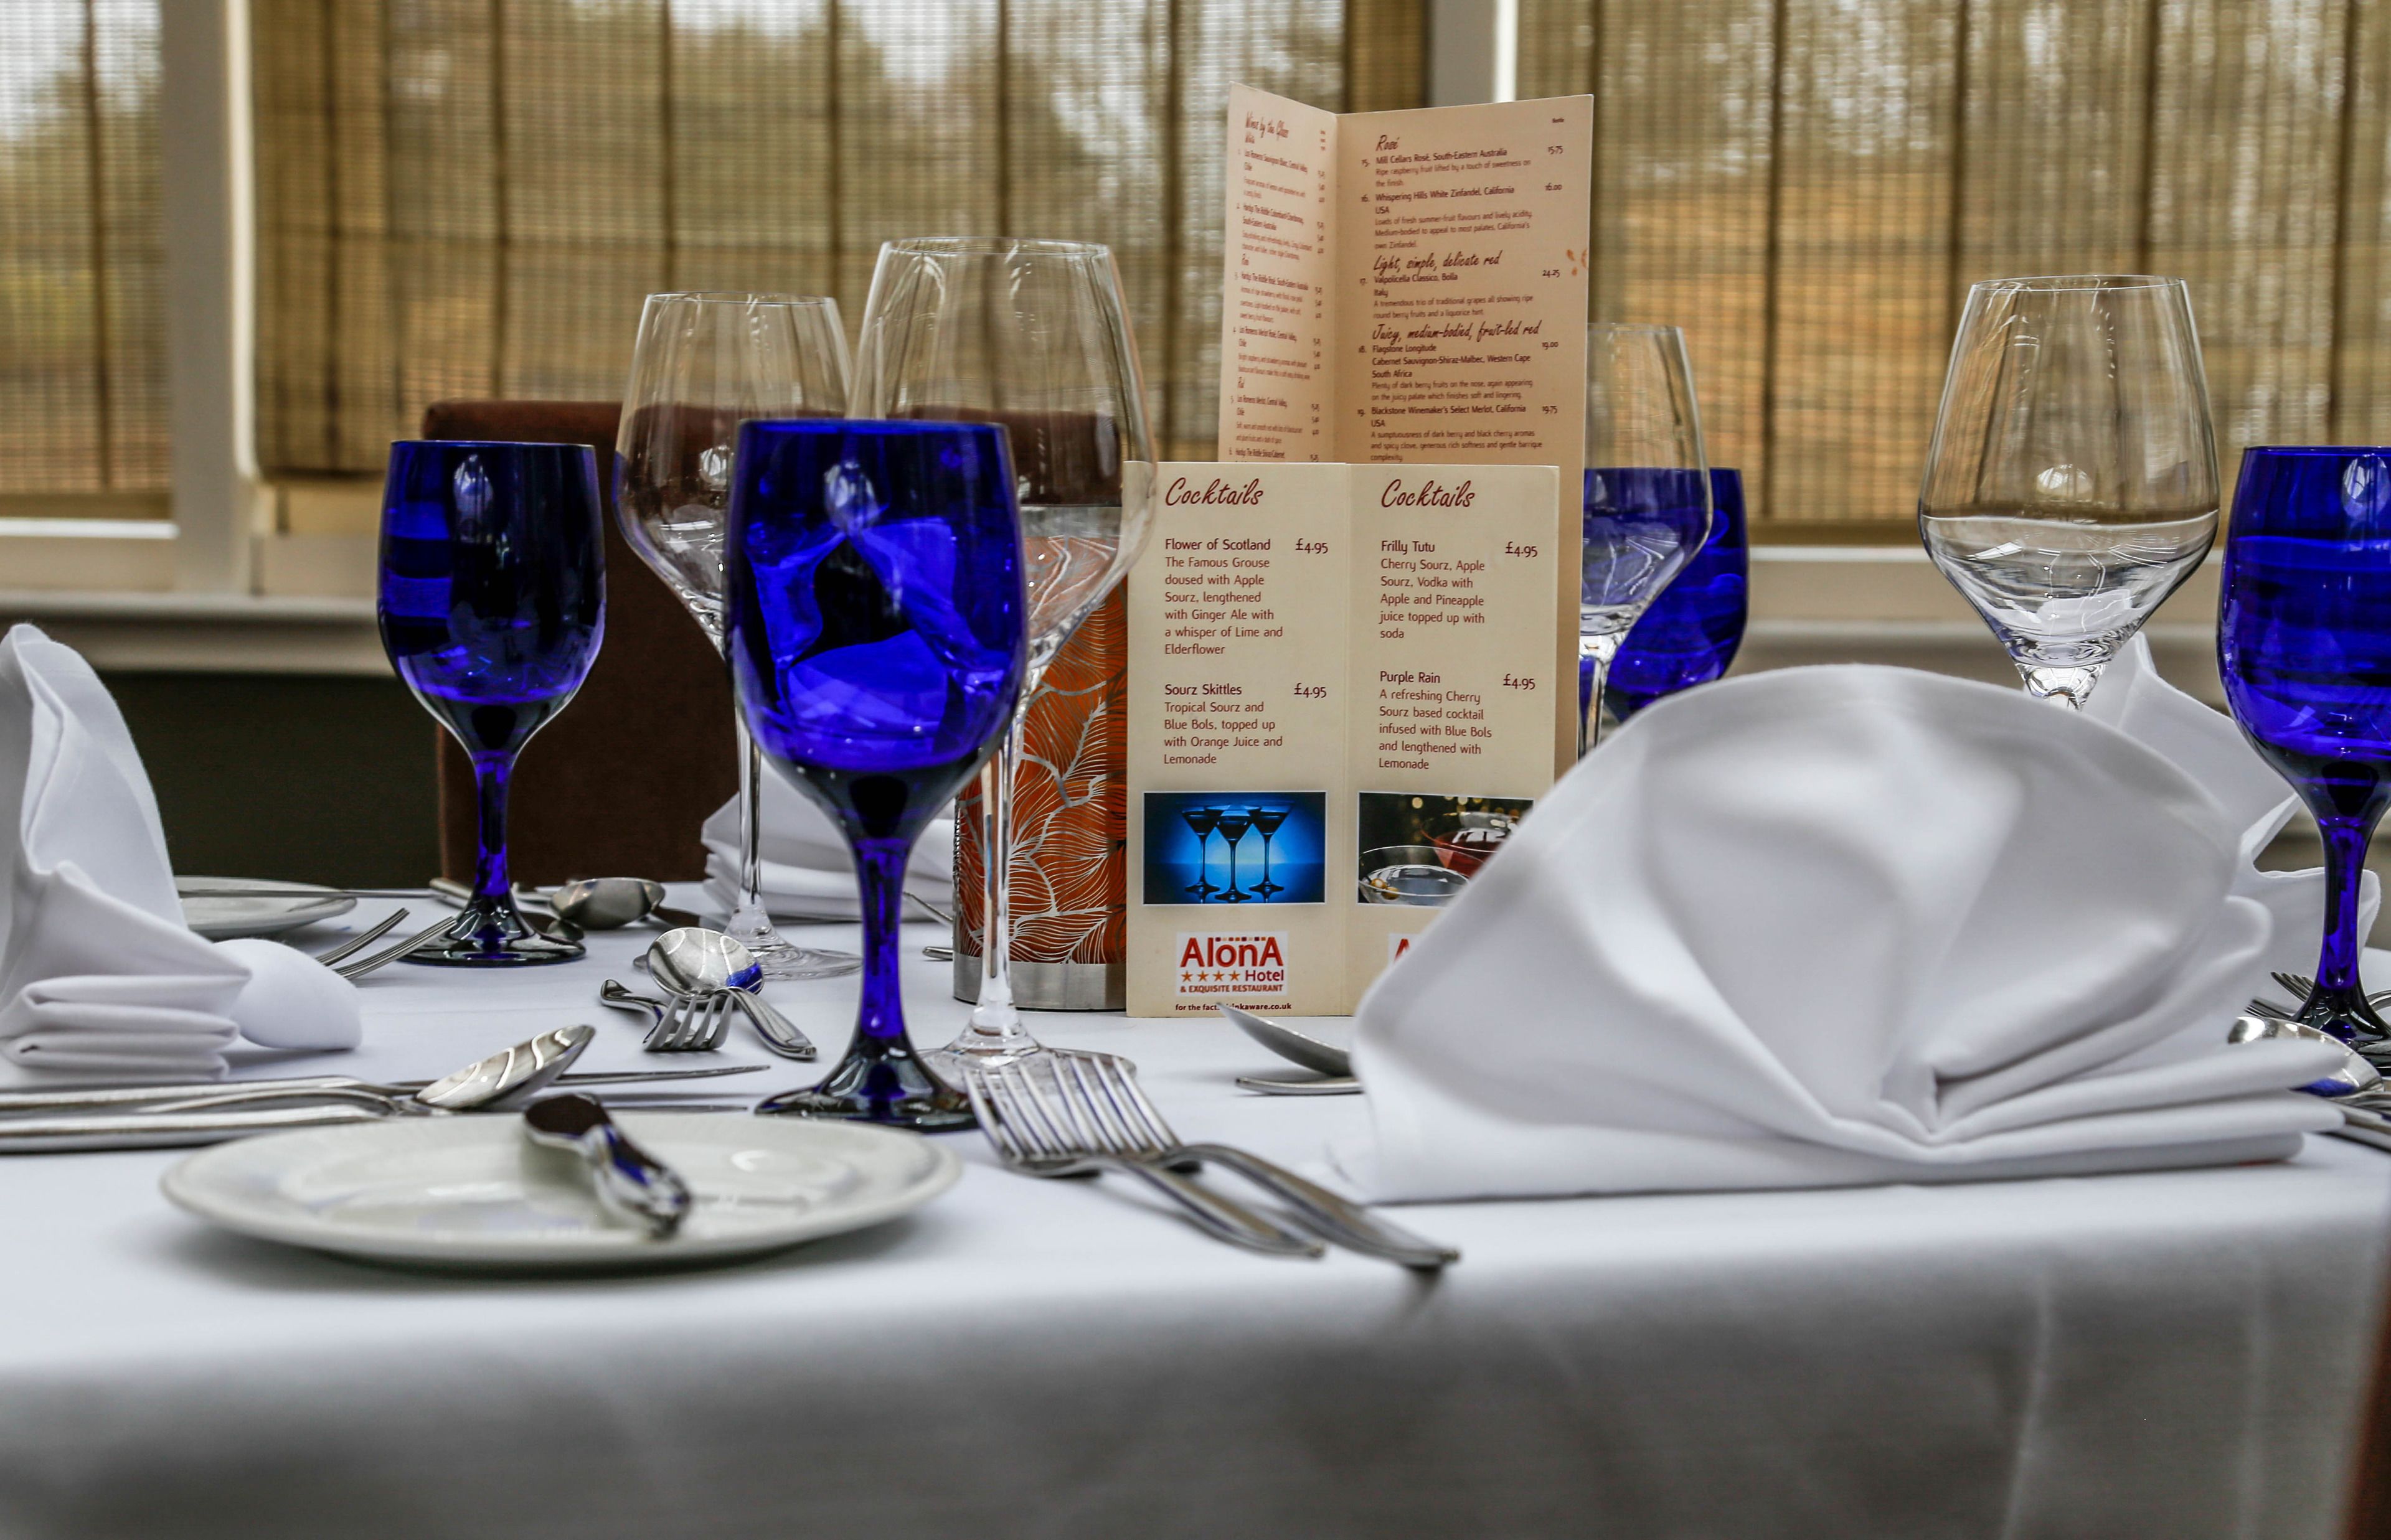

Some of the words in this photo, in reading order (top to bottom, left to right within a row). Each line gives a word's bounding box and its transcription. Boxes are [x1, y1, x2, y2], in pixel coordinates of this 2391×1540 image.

[1375, 134, 1400, 151] Rosé
[1372, 357, 1402, 365] Cabernet
[1166, 477, 1263, 506] Cocktails
[1381, 479, 1475, 507] Cocktails
[1166, 538, 1202, 550] Flower
[1207, 538, 1219, 550] of
[1223, 538, 1270, 550] Scotland
[1295, 538, 1328, 554] £4.95
[1382, 540, 1408, 555] Frilly
[1412, 541, 1435, 552] Tutu
[1505, 542, 1537, 558] £4.95
[1165, 556, 1184, 567] The
[1188, 557, 1229, 568] Famous
[1232, 557, 1270, 568] Grouse
[1381, 558, 1416, 572] Cherry
[1420, 559, 1452, 571] Sourz,
[1456, 560, 1484, 573] Apple
[1165, 574, 1203, 585] doused
[1207, 574, 1230, 585] with
[1233, 574, 1264, 588] Apple
[1381, 576, 1413, 588] Sourz,
[1417, 576, 1448, 587] Vodka
[1451, 577, 1473, 588] with
[1165, 592, 1199, 603] Sourz,
[1203, 591, 1261, 605] lengthened
[1380, 593, 1410, 606] Apple
[1413, 593, 1432, 604] and
[1436, 594, 1484, 609] Pineapple
[1165, 609, 1187, 619] with
[1192, 609, 1227, 622] Ginger
[1230, 609, 1247, 619] Ale
[1251, 609, 1274, 619] with
[1379, 611, 1404, 624] juice
[1408, 611, 1443, 624] topped
[1446, 615, 1460, 626] up
[1463, 613, 1484, 623] with
[1175, 626, 1217, 639] whisper
[1220, 626, 1233, 637] of
[1235, 627, 1260, 637] Lime
[1263, 626, 1283, 637] and
[1380, 627, 1404, 638] soda
[1165, 643, 1225, 654] Elderflower
[1380, 671, 1414, 685] Purple
[1418, 672, 1440, 683] Rain
[1503, 674, 1535, 690] £4.95
[1165, 684, 1198, 695] Sourz
[1202, 683, 1242, 695] Skittles
[1294, 683, 1326, 698] £4.95
[1380, 689, 1387, 698] A
[1391, 688, 1442, 704] refreshing
[1446, 690, 1480, 705] Cherry
[1164, 701, 1207, 715] Tropical
[1210, 702, 1240, 712] Sourz
[1245, 702, 1264, 712] and
[1380, 706, 1409, 717] Sourz
[1413, 706, 1442, 718] based
[1446, 708, 1484, 720] cocktail
[1164, 719, 1187, 730] Blue
[1192, 717, 1217, 730] Bols,
[1222, 718, 1258, 732] topped
[1262, 722, 1275, 732] up
[1380, 723, 1416, 734] infused
[1420, 725, 1441, 735] with
[1445, 725, 1467, 736] Blue
[1471, 726, 1492, 738] Bols
[1164, 736, 1186, 746] with
[1191, 736, 1229, 749] Orange
[1233, 736, 1259, 746] Juice
[1263, 736, 1283, 746] and
[1379, 740, 1398, 751] and
[1402, 740, 1456, 755] lengthened
[1460, 744, 1481, 754] with
[1164, 753, 1217, 764] Lemonade
[1379, 758, 1429, 769] Lemonade
[1181, 937, 1283, 967] AlonA
[1245, 969, 1284, 982] Hotel
[1189, 985, 1230, 993] EXQUISITE
[1232, 984, 1283, 992] RESTAURANT
